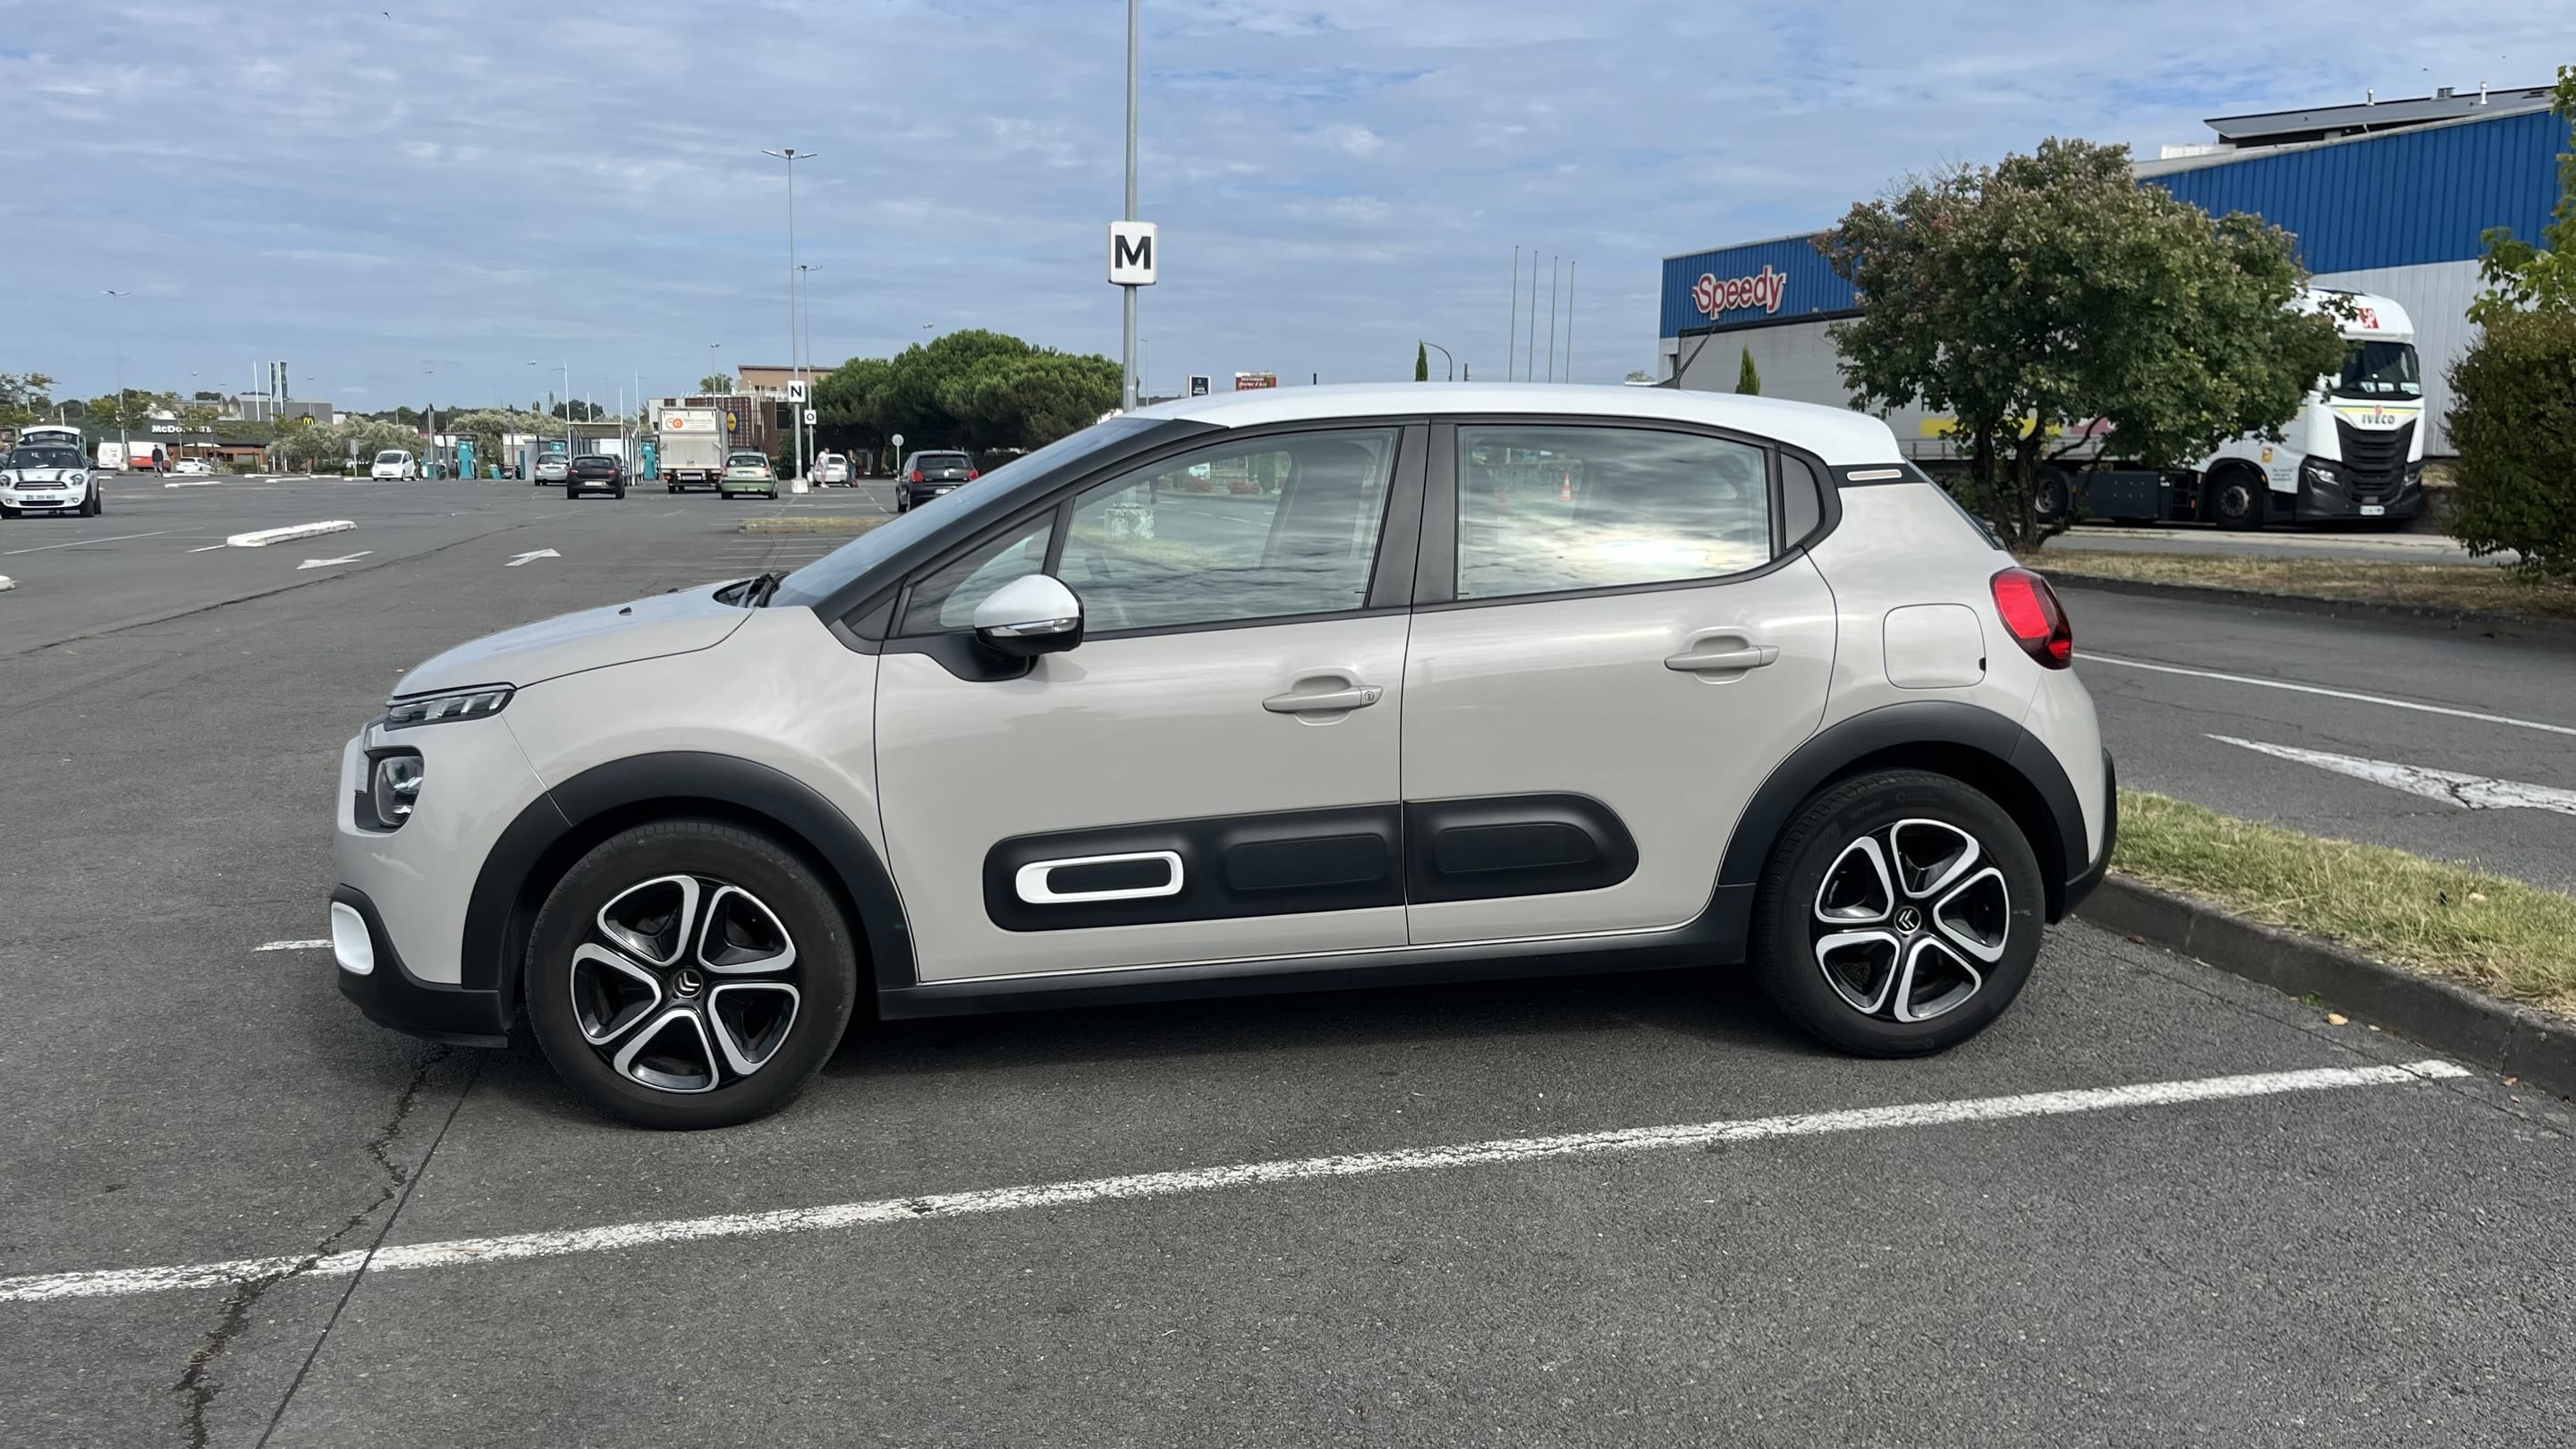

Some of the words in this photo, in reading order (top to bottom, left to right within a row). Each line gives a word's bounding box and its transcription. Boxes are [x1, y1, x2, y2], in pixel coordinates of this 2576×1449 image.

[1114, 234, 1151, 270] M
[1692, 265, 1787, 320] Speedy
[790, 385, 801, 397] N
[806, 412, 815, 421] O
[2361, 414, 2395, 425] IVECO
